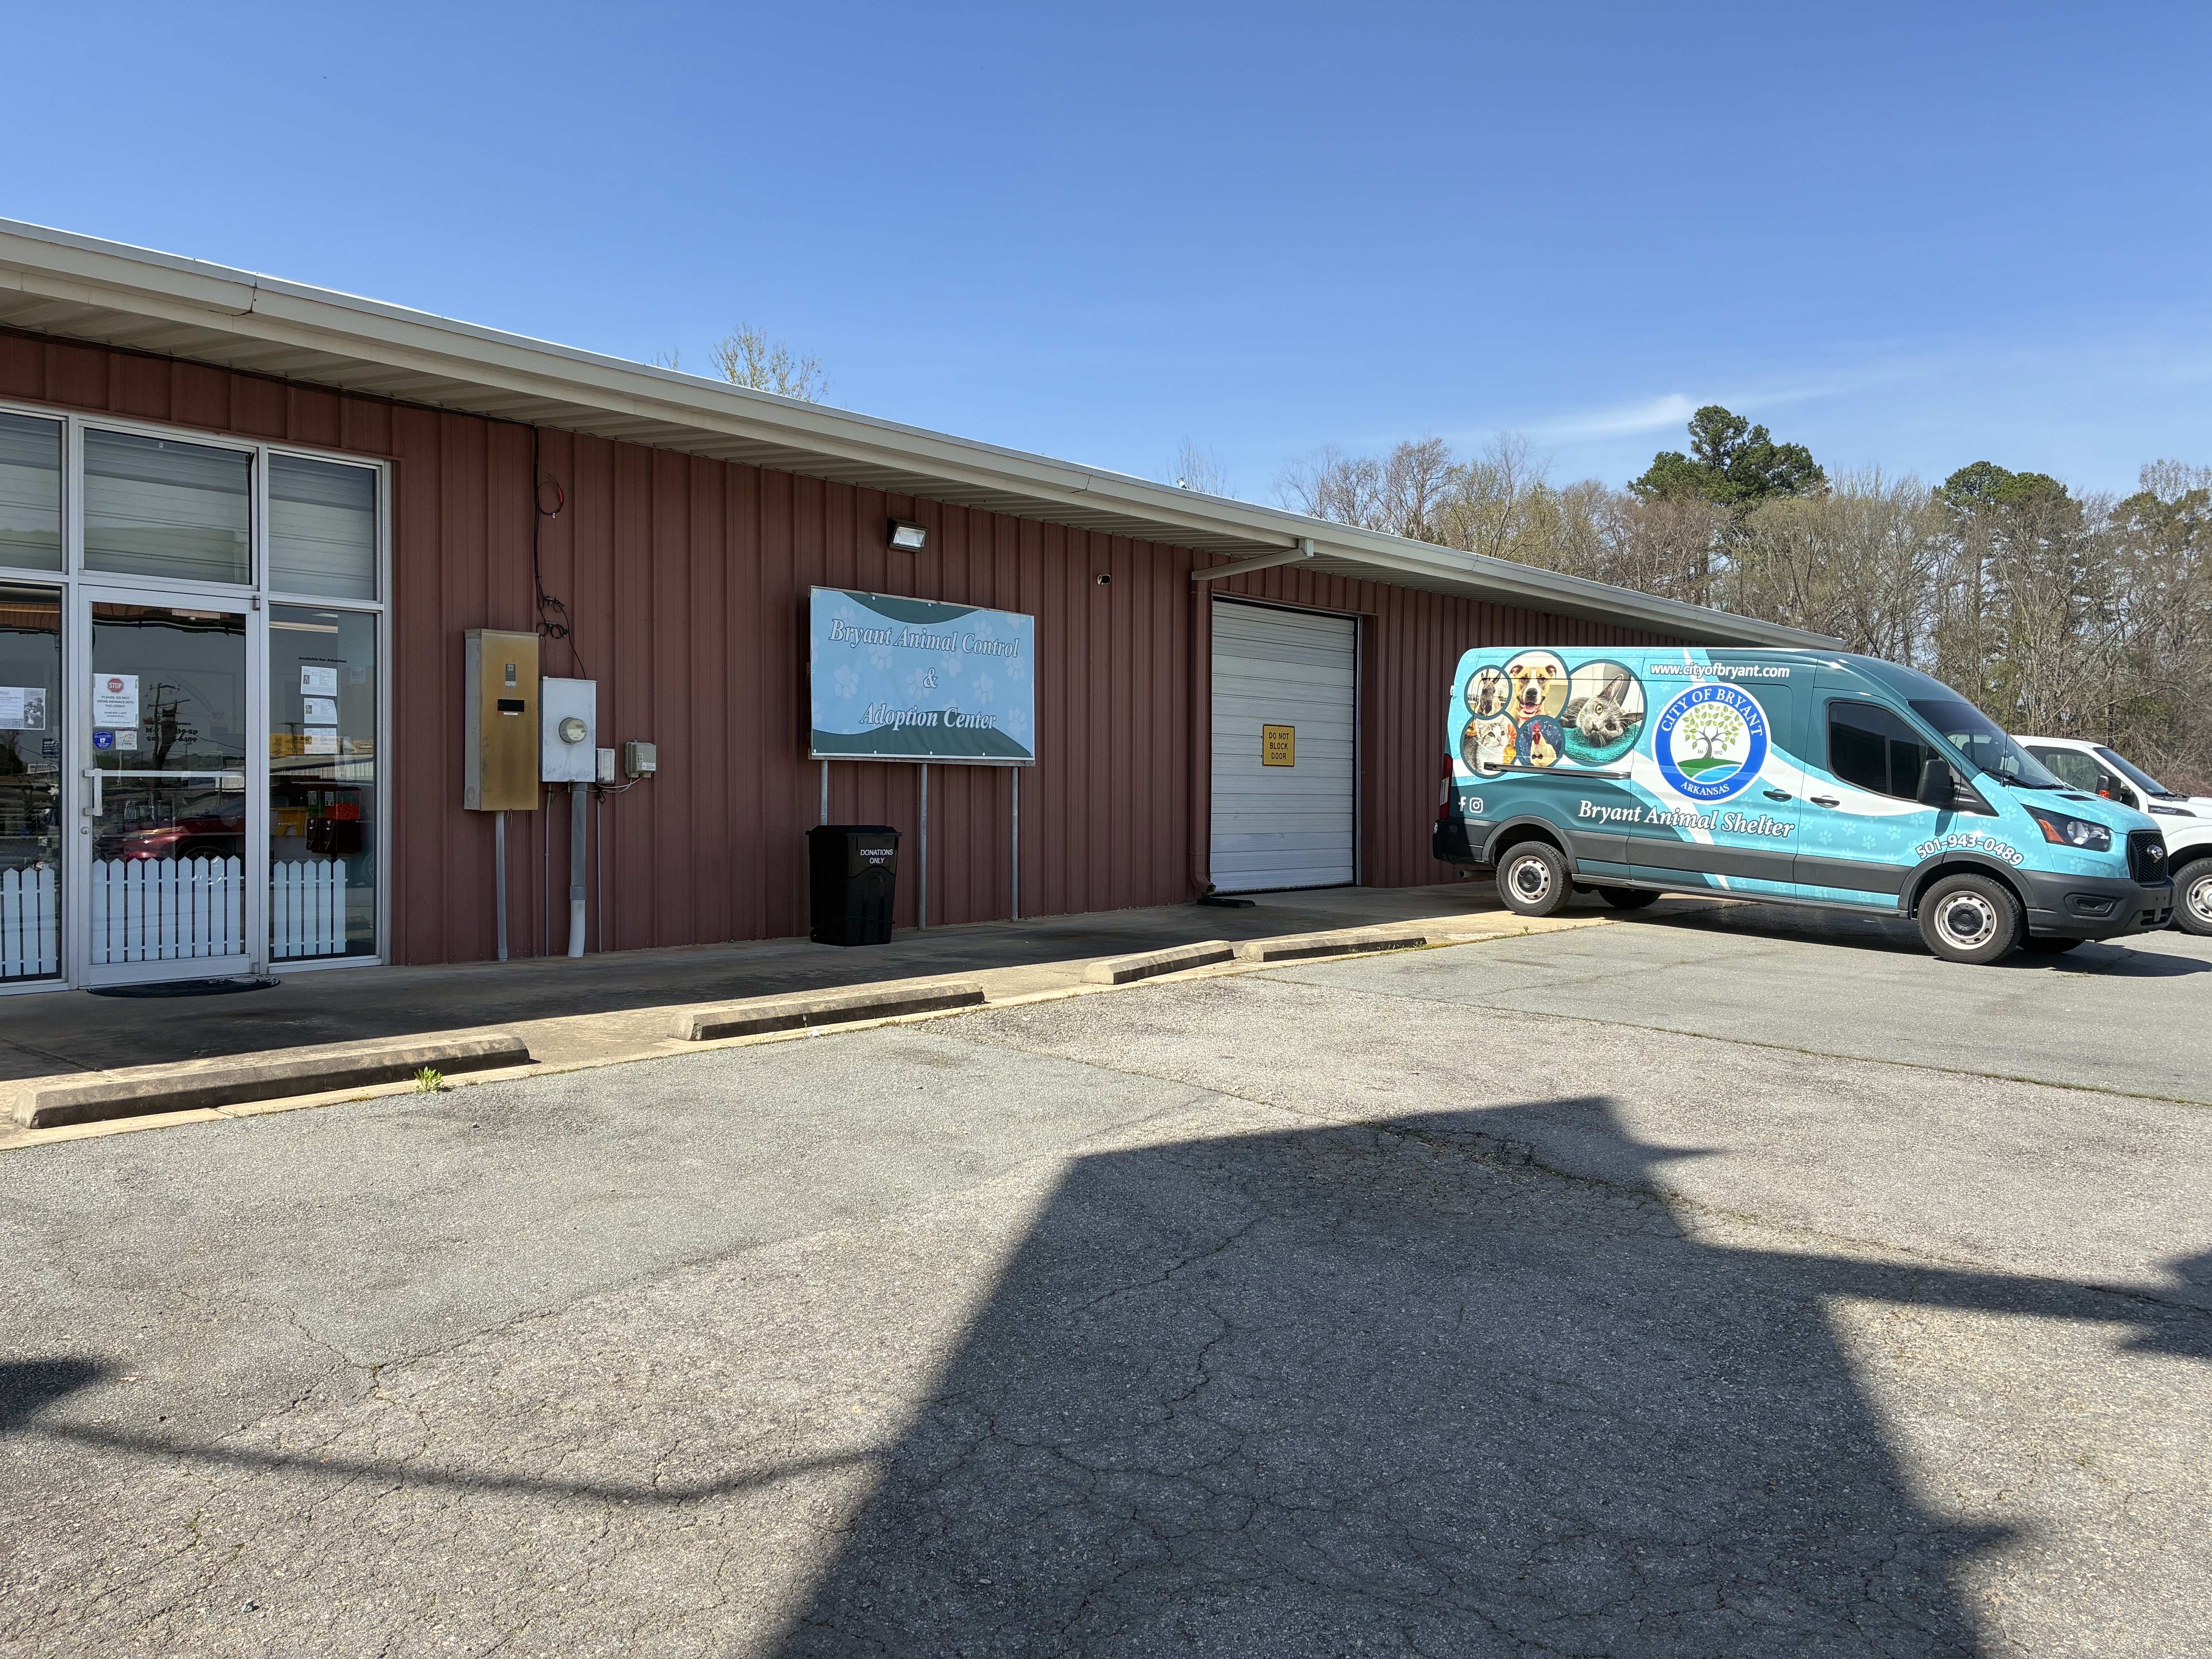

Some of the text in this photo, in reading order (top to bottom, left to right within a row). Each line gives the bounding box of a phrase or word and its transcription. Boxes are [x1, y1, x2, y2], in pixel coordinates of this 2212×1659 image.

[829, 619, 1019, 658] Bryant Animal Control
[923, 667, 938, 689] &
[1650, 662, 1790, 679] www.cityofbryant.com
[859, 702, 996, 731] Adoption Center
[1661, 689, 1763, 736] CITY OF BRYANT
[1680, 781, 1730, 795] ARKANSAS
[1578, 800, 1795, 839] Bryant Animal Shelter
[1915, 833, 2024, 866] 501-943-0489
